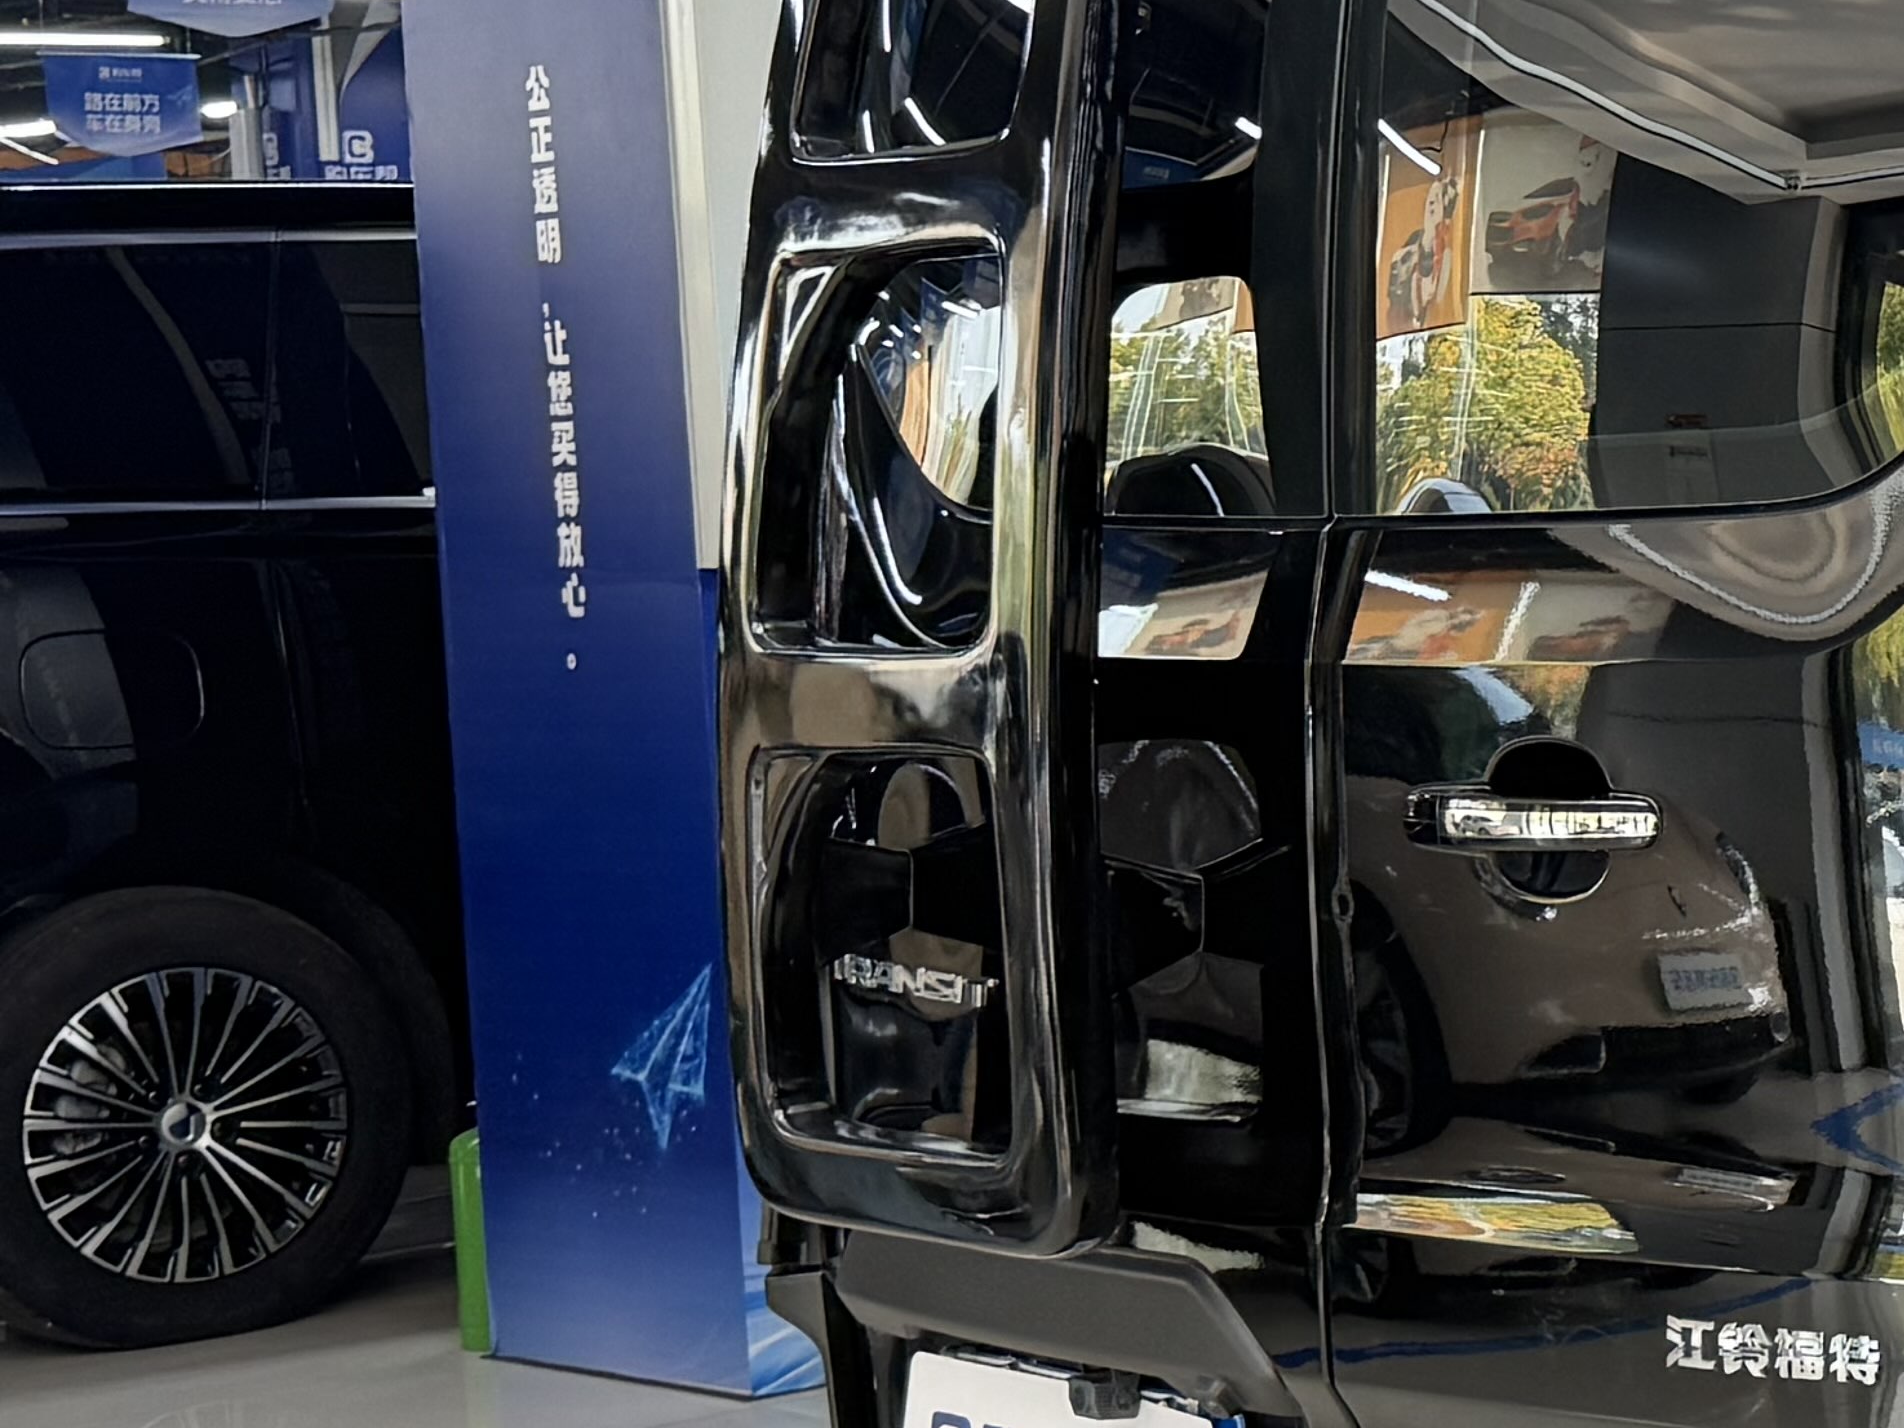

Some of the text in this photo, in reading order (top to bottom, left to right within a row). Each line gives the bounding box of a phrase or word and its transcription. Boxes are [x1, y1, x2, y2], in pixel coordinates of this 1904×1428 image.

[83, 91, 161, 114] 路在前方
[1665, 1313, 1882, 1387] 江铃福特
